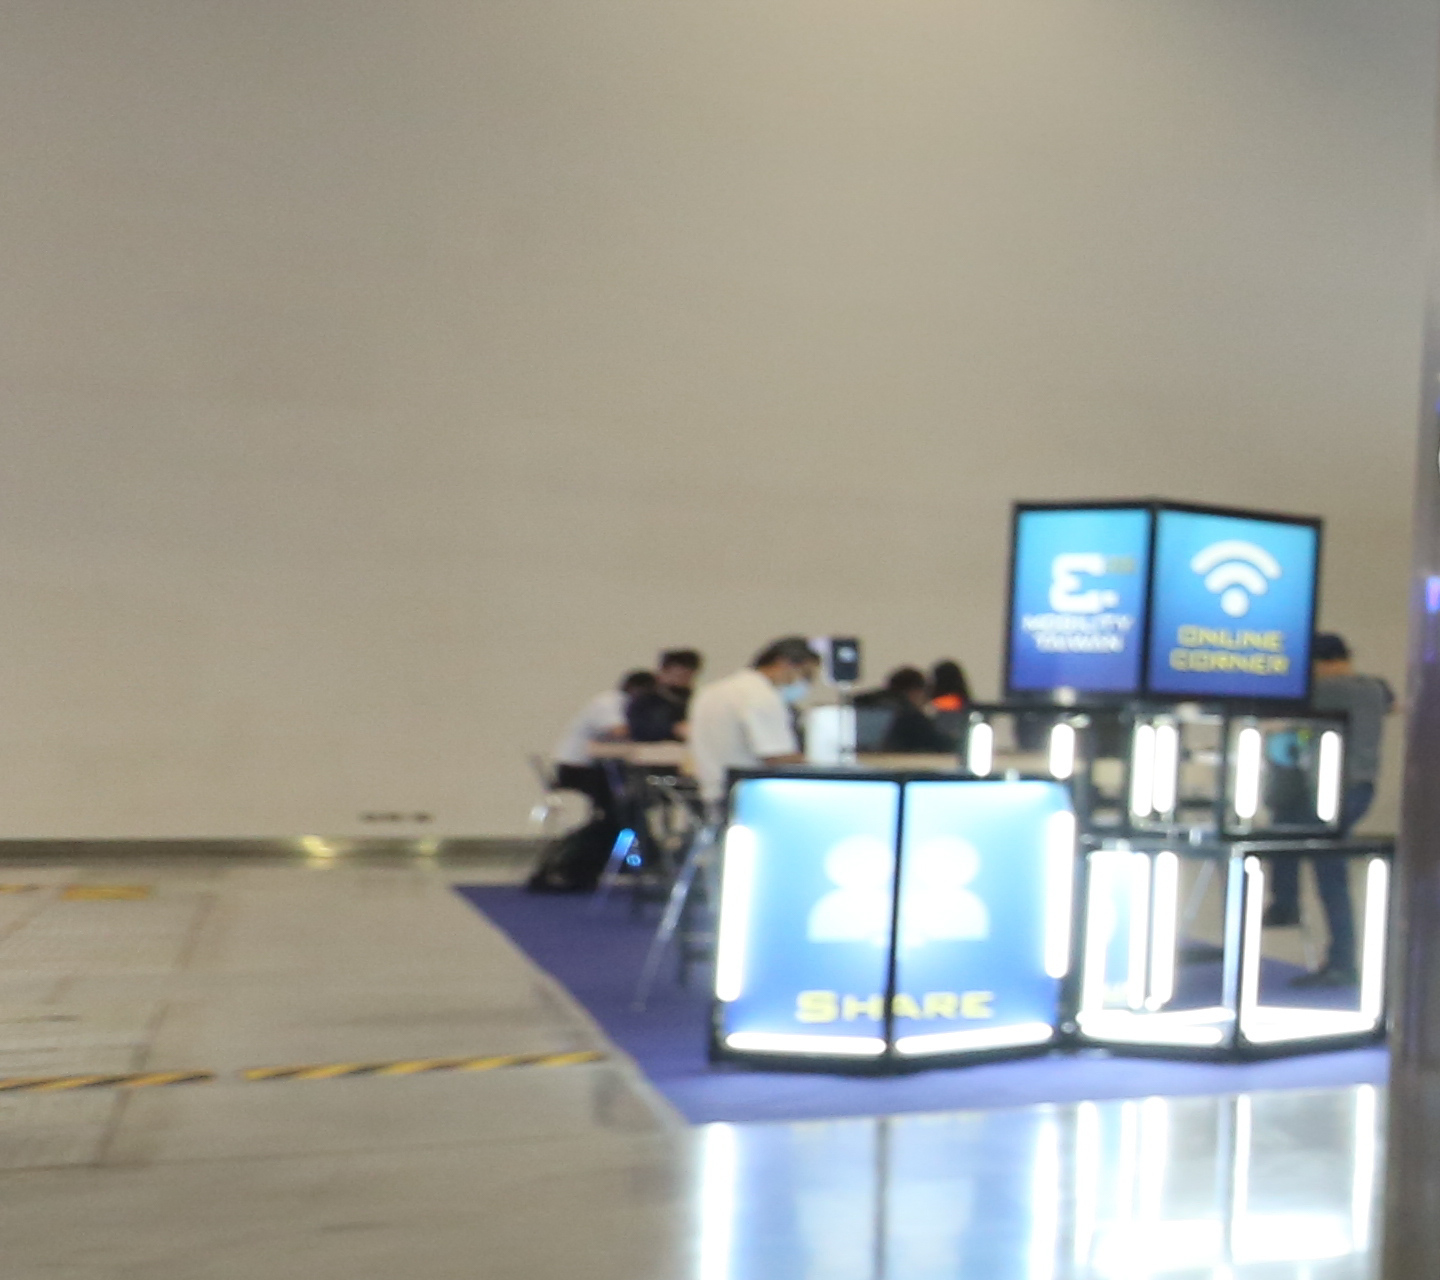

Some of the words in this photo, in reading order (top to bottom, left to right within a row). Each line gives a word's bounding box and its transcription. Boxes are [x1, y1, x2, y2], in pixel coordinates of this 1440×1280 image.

[1176, 624, 1284, 653] ONLINE
[1168, 646, 1291, 677] CORNER
[795, 989, 996, 1024] SHARE
